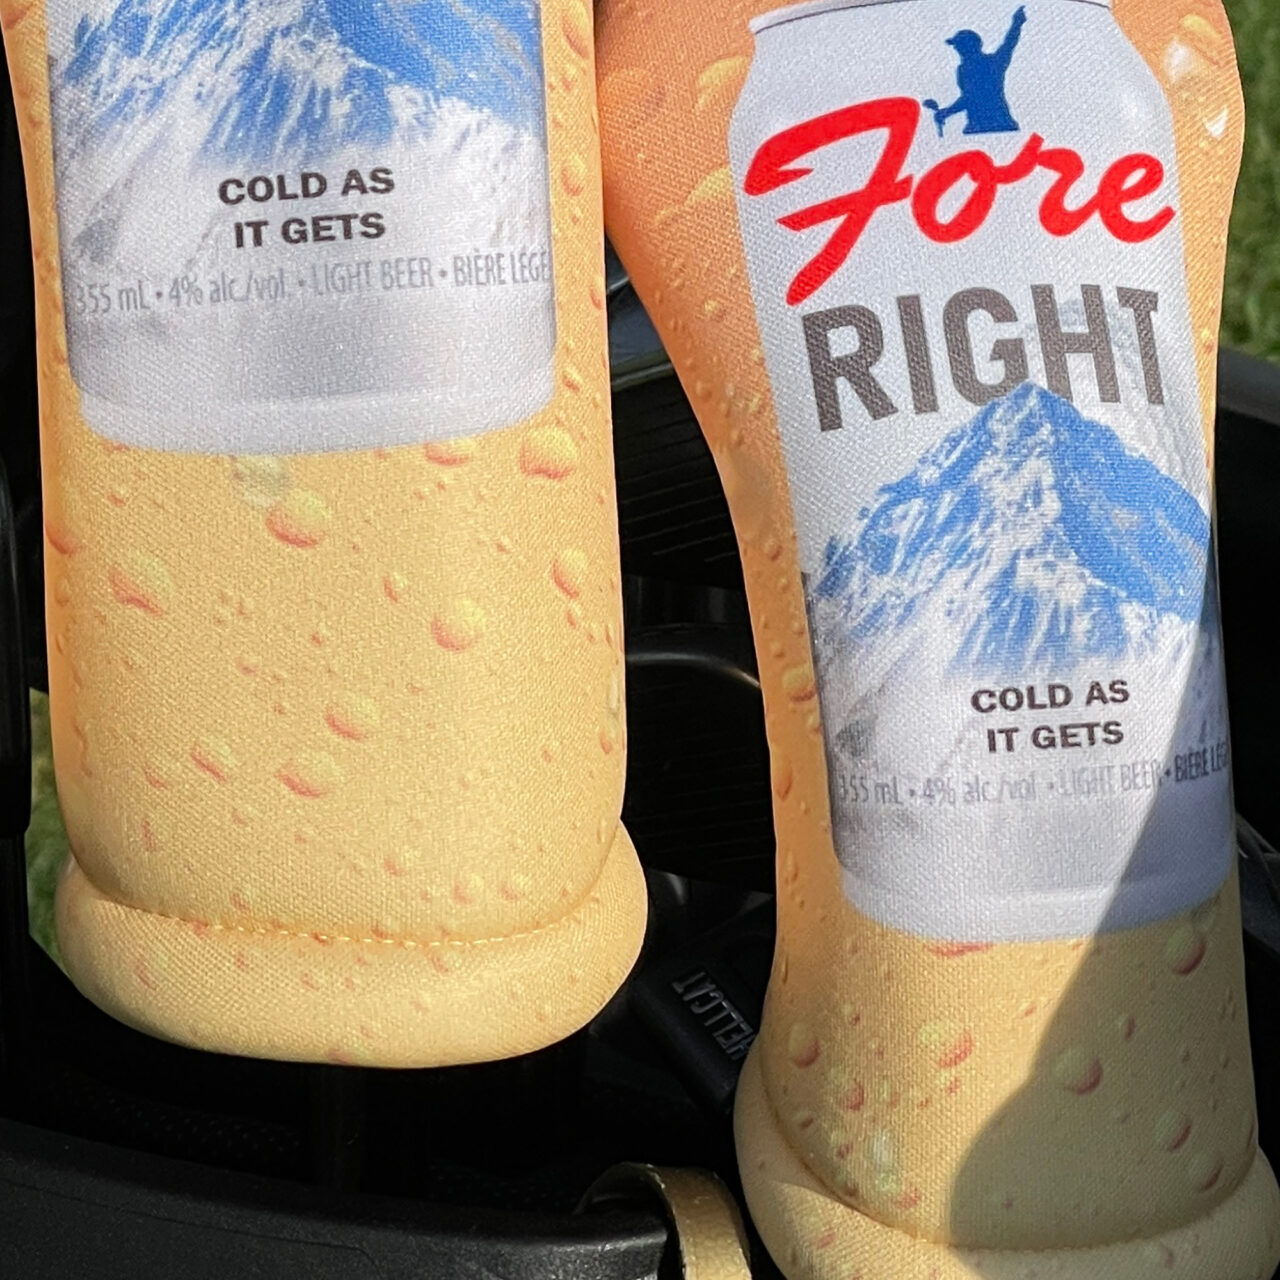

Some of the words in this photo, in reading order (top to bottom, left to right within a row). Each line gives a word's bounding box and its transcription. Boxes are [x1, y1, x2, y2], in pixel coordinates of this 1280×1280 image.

[217, 171, 328, 206] COLD
[340, 166, 396, 197] AS
[744, 96, 1176, 307] Fore
[233, 220, 269, 249] IT
[281, 212, 386, 245] GETS
[75, 281, 112, 314] 355
[170, 275, 203, 308] 4%
[311, 261, 372, 296] LIGHT
[380, 256, 435, 291] BEER
[453, 248, 507, 287] BIÈRE
[801, 283, 1165, 433] RIGHT
[970, 683, 1073, 713] COLD
[1084, 679, 1130, 705] AS
[986, 727, 1020, 753] IT
[1032, 721, 1124, 750] GETS
